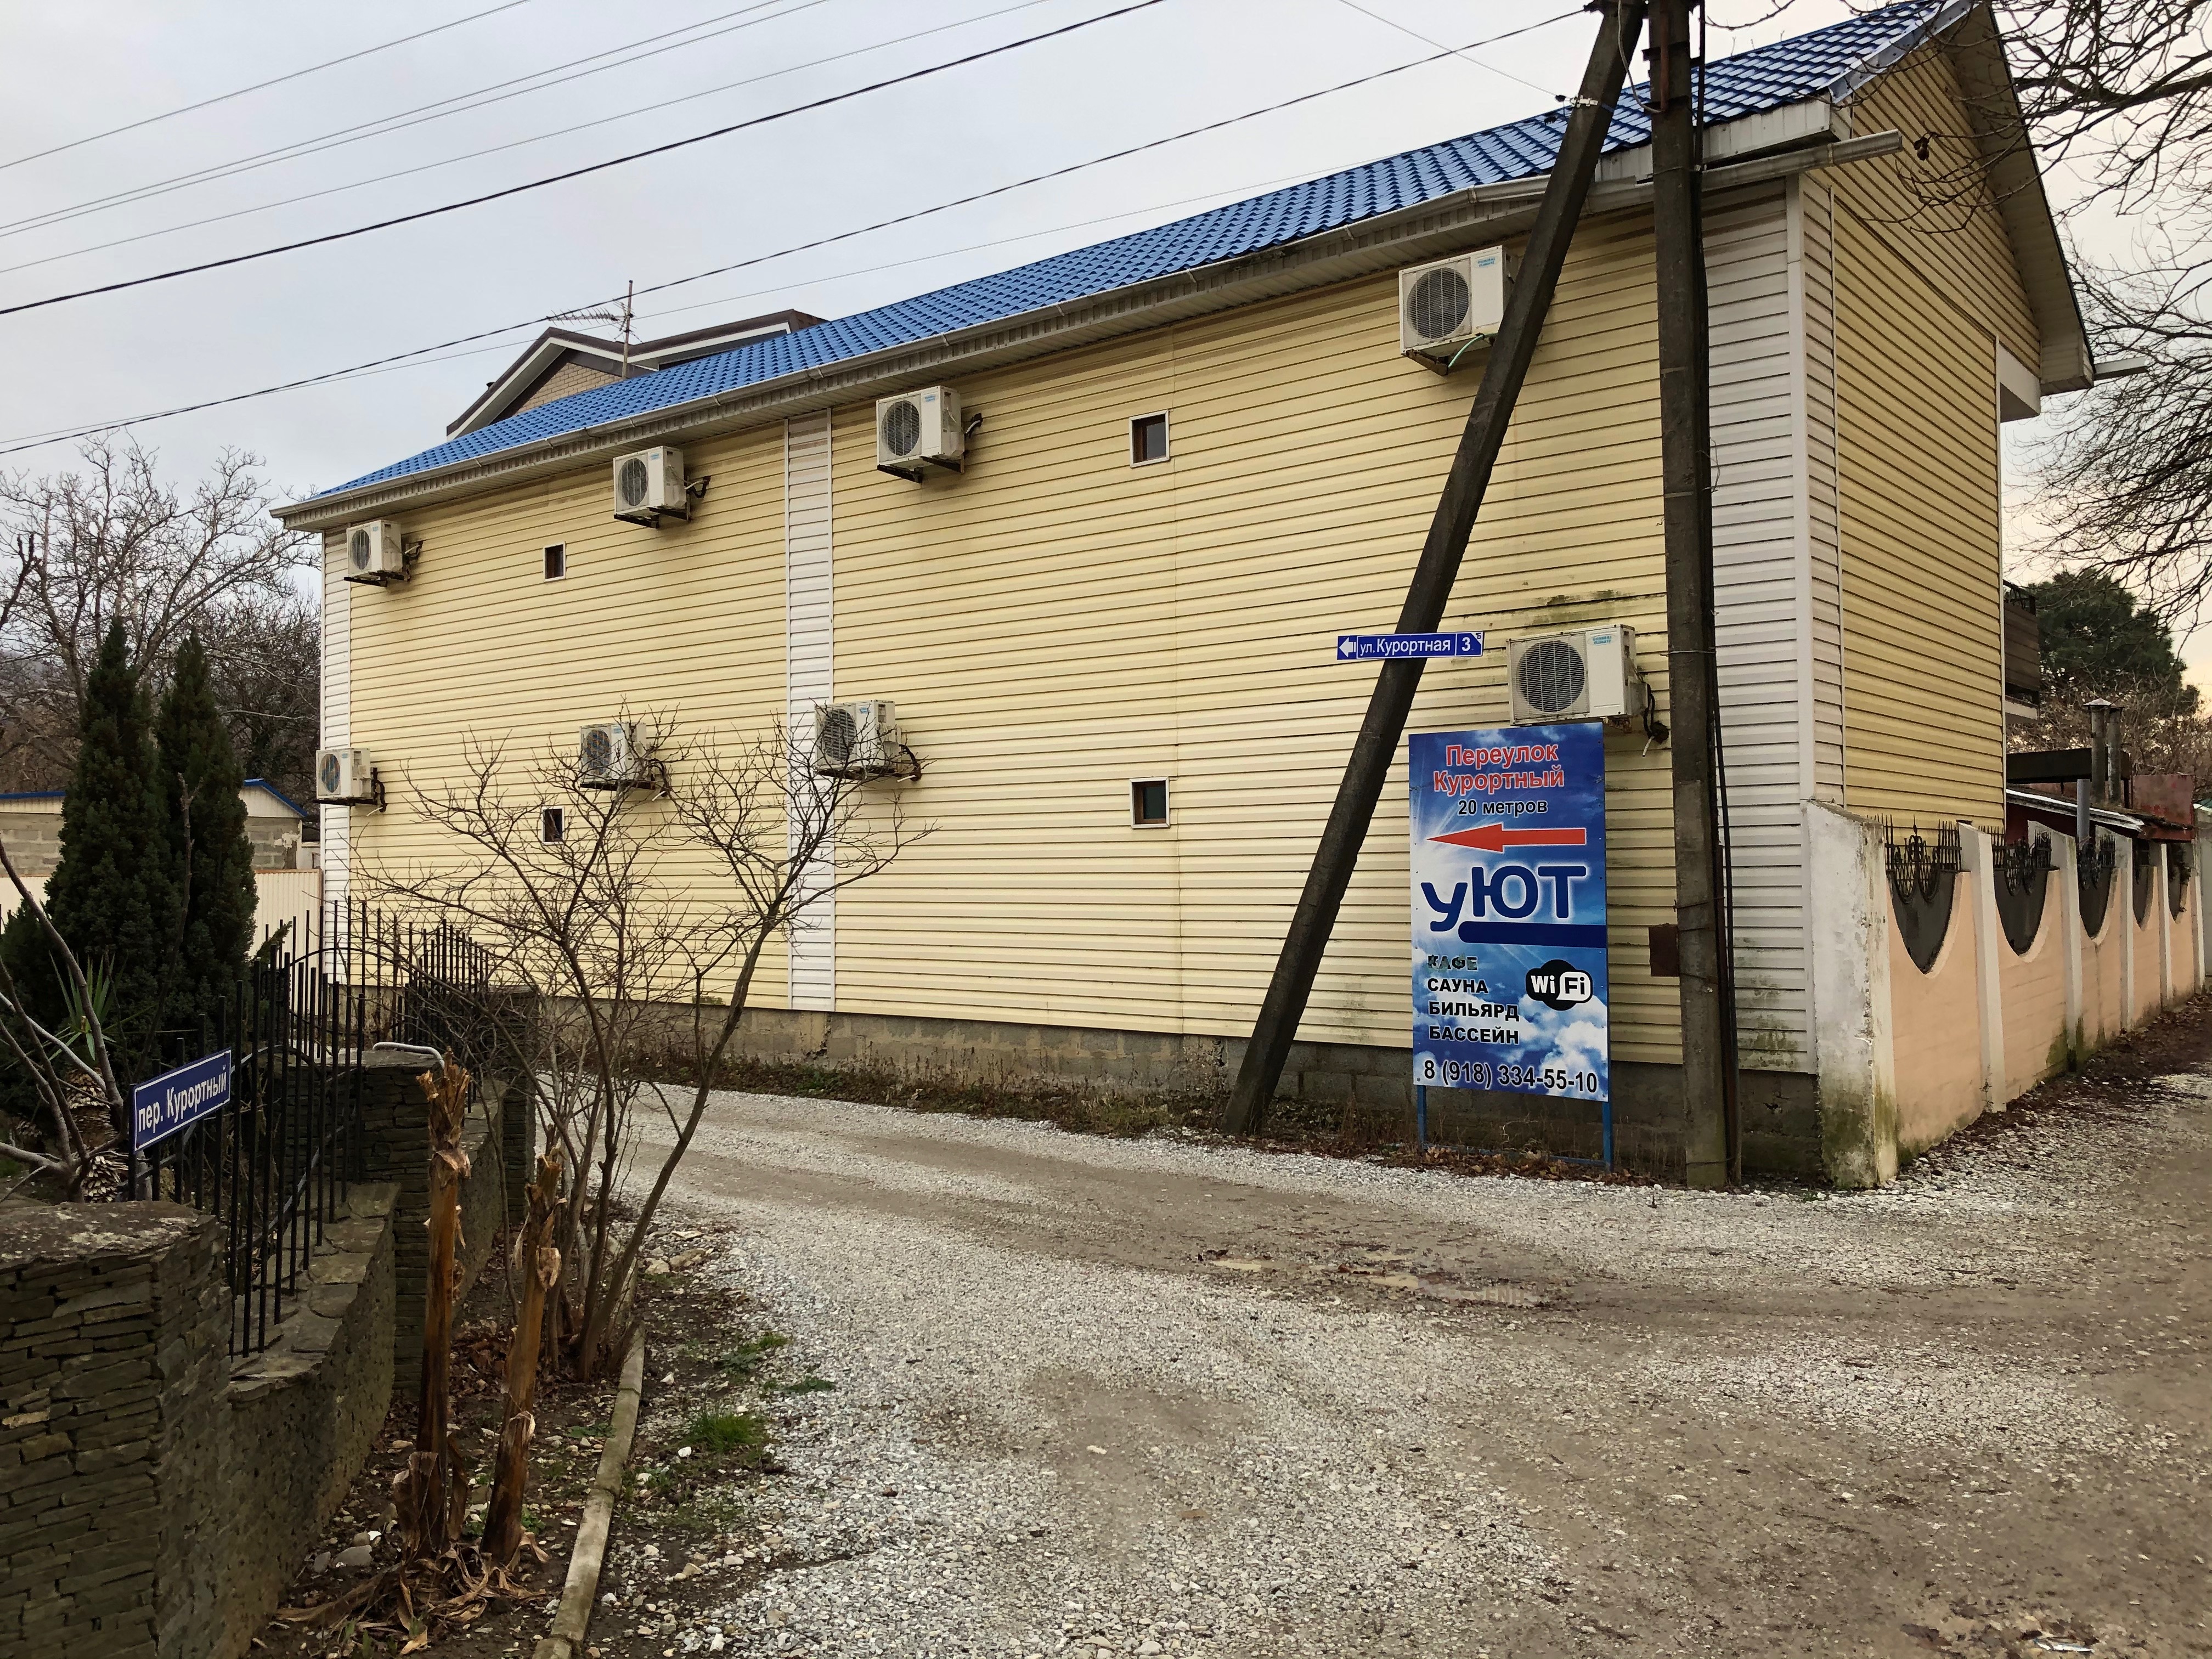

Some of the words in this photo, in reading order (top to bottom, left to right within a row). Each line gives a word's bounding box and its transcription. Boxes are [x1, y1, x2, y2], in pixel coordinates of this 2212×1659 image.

[1447, 744, 1559, 769] Переулок
[1434, 765, 1565, 795] Курортный
[1458, 800, 1477, 815] 20
[1483, 801, 1548, 817] метров
[1427, 978, 1489, 994] САУНА
[1429, 1001, 1520, 1022] БИЛЬЯРД
[1430, 1025, 1519, 1044] БАССЕЙН
[1424, 1060, 1435, 1079] 8
[1442, 1060, 1492, 1089] (918)
[1498, 1065, 1598, 1093] 334-55-10
[138, 1102, 163, 1133] пер.
[166, 1064, 227, 1124] Курортный
